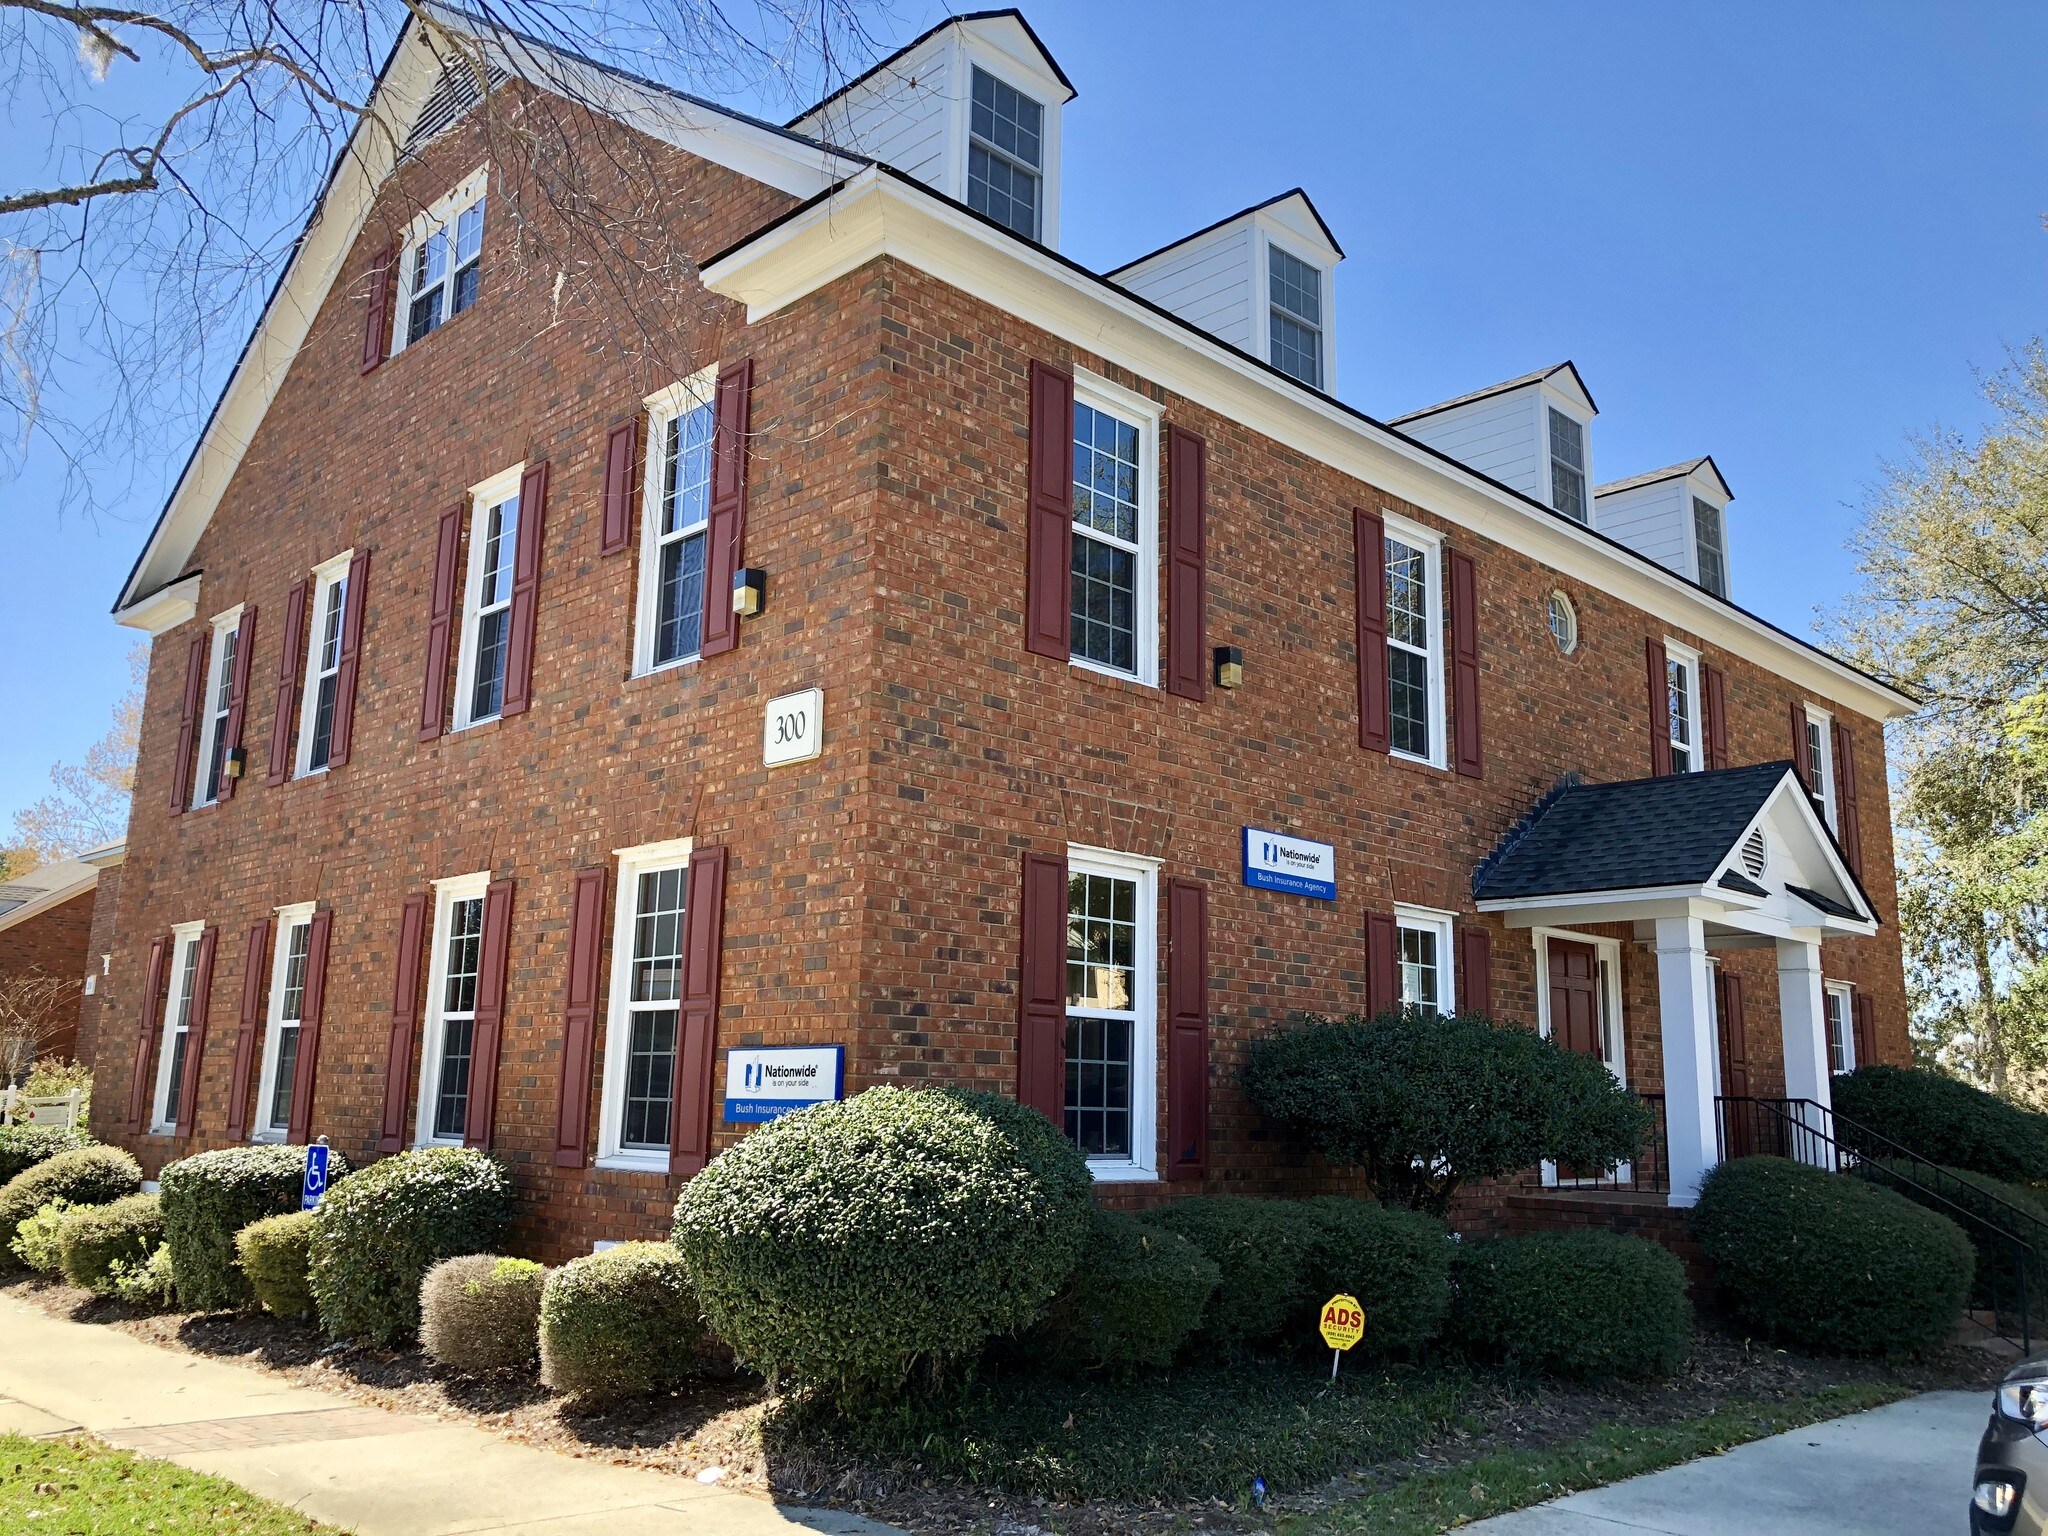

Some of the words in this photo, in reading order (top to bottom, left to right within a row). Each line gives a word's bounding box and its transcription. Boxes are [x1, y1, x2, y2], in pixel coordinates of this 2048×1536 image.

[775, 711, 806, 745] 300
[1280, 846, 1320, 864] Nationwide
[1258, 873, 1273, 882] Bush
[1275, 876, 1303, 888] Insurance
[1305, 882, 1326, 893] Agency
[765, 1064, 816, 1077] Nationwide
[784, 1080, 797, 1088] your
[735, 1103, 753, 1114] Bush
[1324, 1306, 1361, 1328] ADS
[1324, 1323, 1359, 1333] SECURITY
